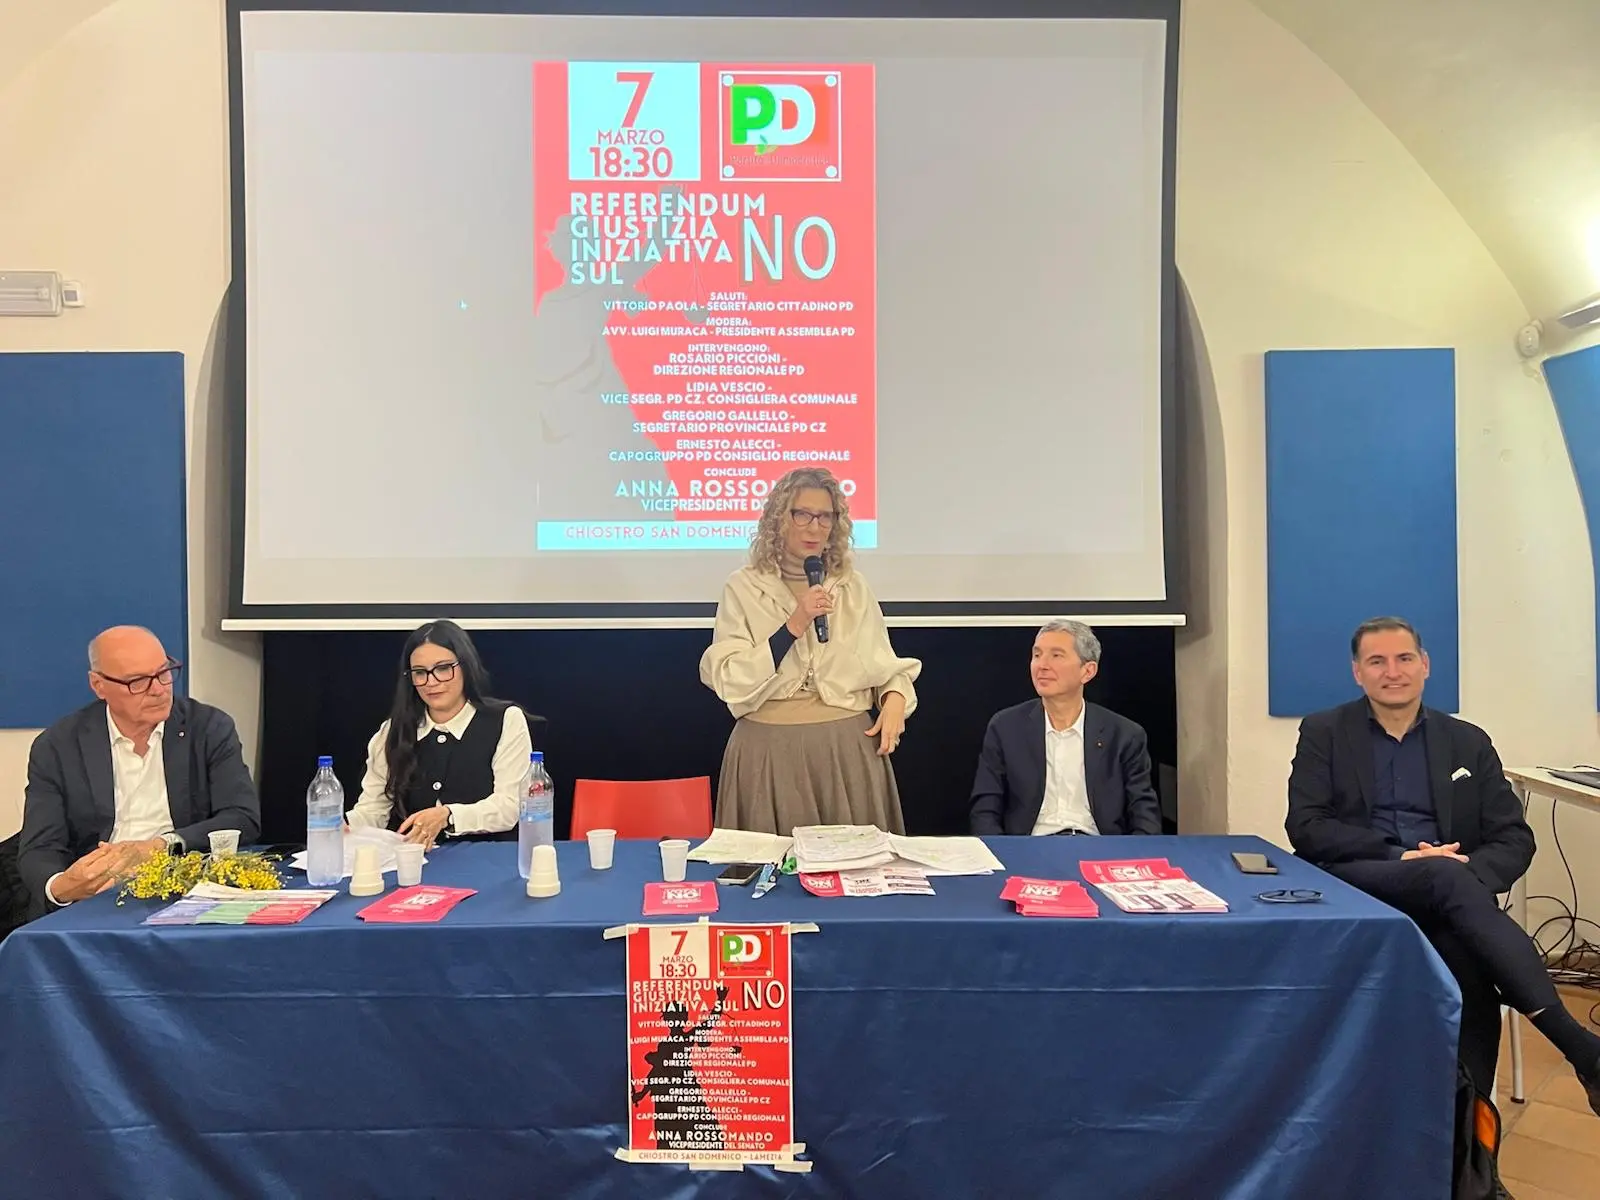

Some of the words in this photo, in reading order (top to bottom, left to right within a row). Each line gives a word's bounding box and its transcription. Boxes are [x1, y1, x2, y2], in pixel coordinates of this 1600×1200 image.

[615, 72, 654, 128] 7
[730, 84, 816, 146] PD
[598, 129, 665, 145] MARZO
[589, 146, 673, 178] 18:30
[570, 192, 765, 216] REFERENDUM
[570, 216, 718, 239] GIUSTIZIA
[571, 239, 733, 262] INIZIATIVA
[743, 214, 836, 282] NO
[571, 262, 624, 285] SUL
[603, 301, 657, 311] VITTORIO
[658, 301, 698, 311] PAOLA
[707, 301, 775, 311] SEGRETARIO
[776, 302, 837, 311] CITTADINO
[838, 302, 854, 311] PD
[602, 326, 630, 336] AVV.
[631, 326, 659, 336] LUIGI
[660, 327, 708, 336] MURACA
[715, 327, 776, 336] PRESIDENTE
[778, 327, 840, 336] ASSEMBLEA
[841, 327, 855, 336] PD
[669, 353, 725, 363] ROSARIO
[727, 353, 781, 363] PICCIONI
[653, 365, 717, 375] DIREZIONE
[719, 365, 787, 375] REGIONALE
[788, 365, 805, 375] PD
[686, 382, 718, 392] LIDIA
[720, 382, 766, 392] VESCIO
[601, 394, 629, 404] VICE
[630, 394, 665, 404] SEGR.
[667, 394, 683, 404] PD
[707, 394, 788, 404] CONSIGLIERA
[789, 394, 857, 404] COMUNALE
[662, 410, 726, 421] GREGORIO
[728, 410, 788, 421] GALLELLO
[632, 422, 708, 433] SEGRETARIO
[709, 422, 790, 433] PROVINCIALE
[792, 422, 808, 433] PD
[810, 422, 827, 433] CZ
[676, 439, 730, 449] ERNESTO
[732, 439, 775, 449] ALECCI
[608, 451, 694, 461] CAPOGRUPPO
[696, 451, 711, 461] PD
[714, 451, 780, 461] CONSIGLIO
[782, 451, 850, 461] REGIONALE
[704, 468, 757, 477] CONCLUDE
[615, 480, 679, 497] ANNA
[689, 480, 856, 497] ROSSOO
[641, 499, 747, 511] VICEPRESIDENTE
[566, 526, 644, 538] CHIOSTRO
[651, 526, 680, 538] SAN
[671, 931, 688, 955] 7
[722, 935, 762, 963] PD
[662, 955, 694, 963] MARZO
[660, 964, 697, 977] 18:30
[633, 979, 724, 992] REFERENDUM
[633, 991, 701, 1002] GIUSTIZIA
[743, 979, 785, 1010] NO
[633, 1001, 708, 1013] INIZIATIVA
[714, 1000, 739, 1012] SUL
[630, 1036, 650, 1044] LUIGI
[709, 1088, 746, 1096] GALLELLO
[698, 1095, 748, 1103] PROVINCIALE
[648, 1130, 681, 1140] ANNA
[686, 1131, 773, 1142] ROSSOMANDO
[668, 1141, 723, 1149] VICEPRESIDENTE
[638, 1152, 678, 1160] CHIOSTRO
[681, 1152, 696, 1160] SAN
